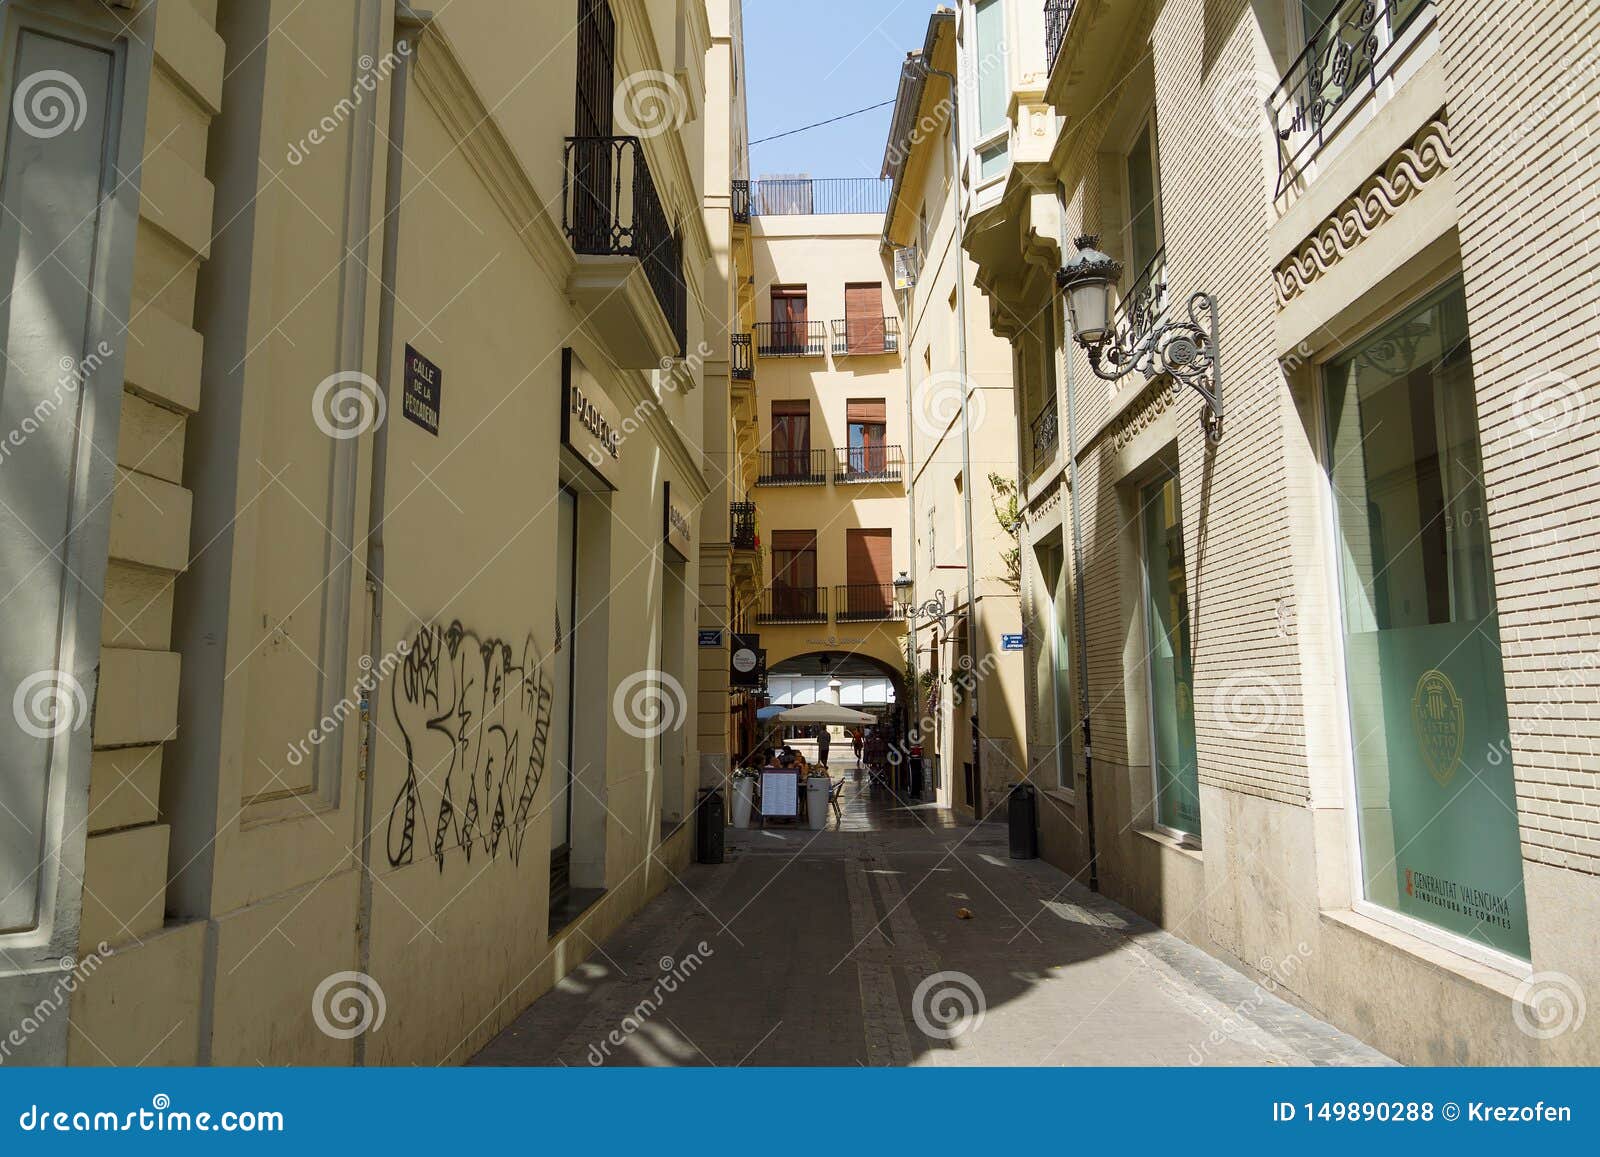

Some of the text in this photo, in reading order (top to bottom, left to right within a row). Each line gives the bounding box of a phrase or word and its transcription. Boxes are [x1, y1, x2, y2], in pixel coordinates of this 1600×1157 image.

[413, 358, 434, 384] CALLE
[414, 379, 432, 401] DE LA
[1414, 871, 1510, 917] GENERALITAT VALENCIANA
[1415, 890, 1511, 930] SINDICATURA DE COMPTES
